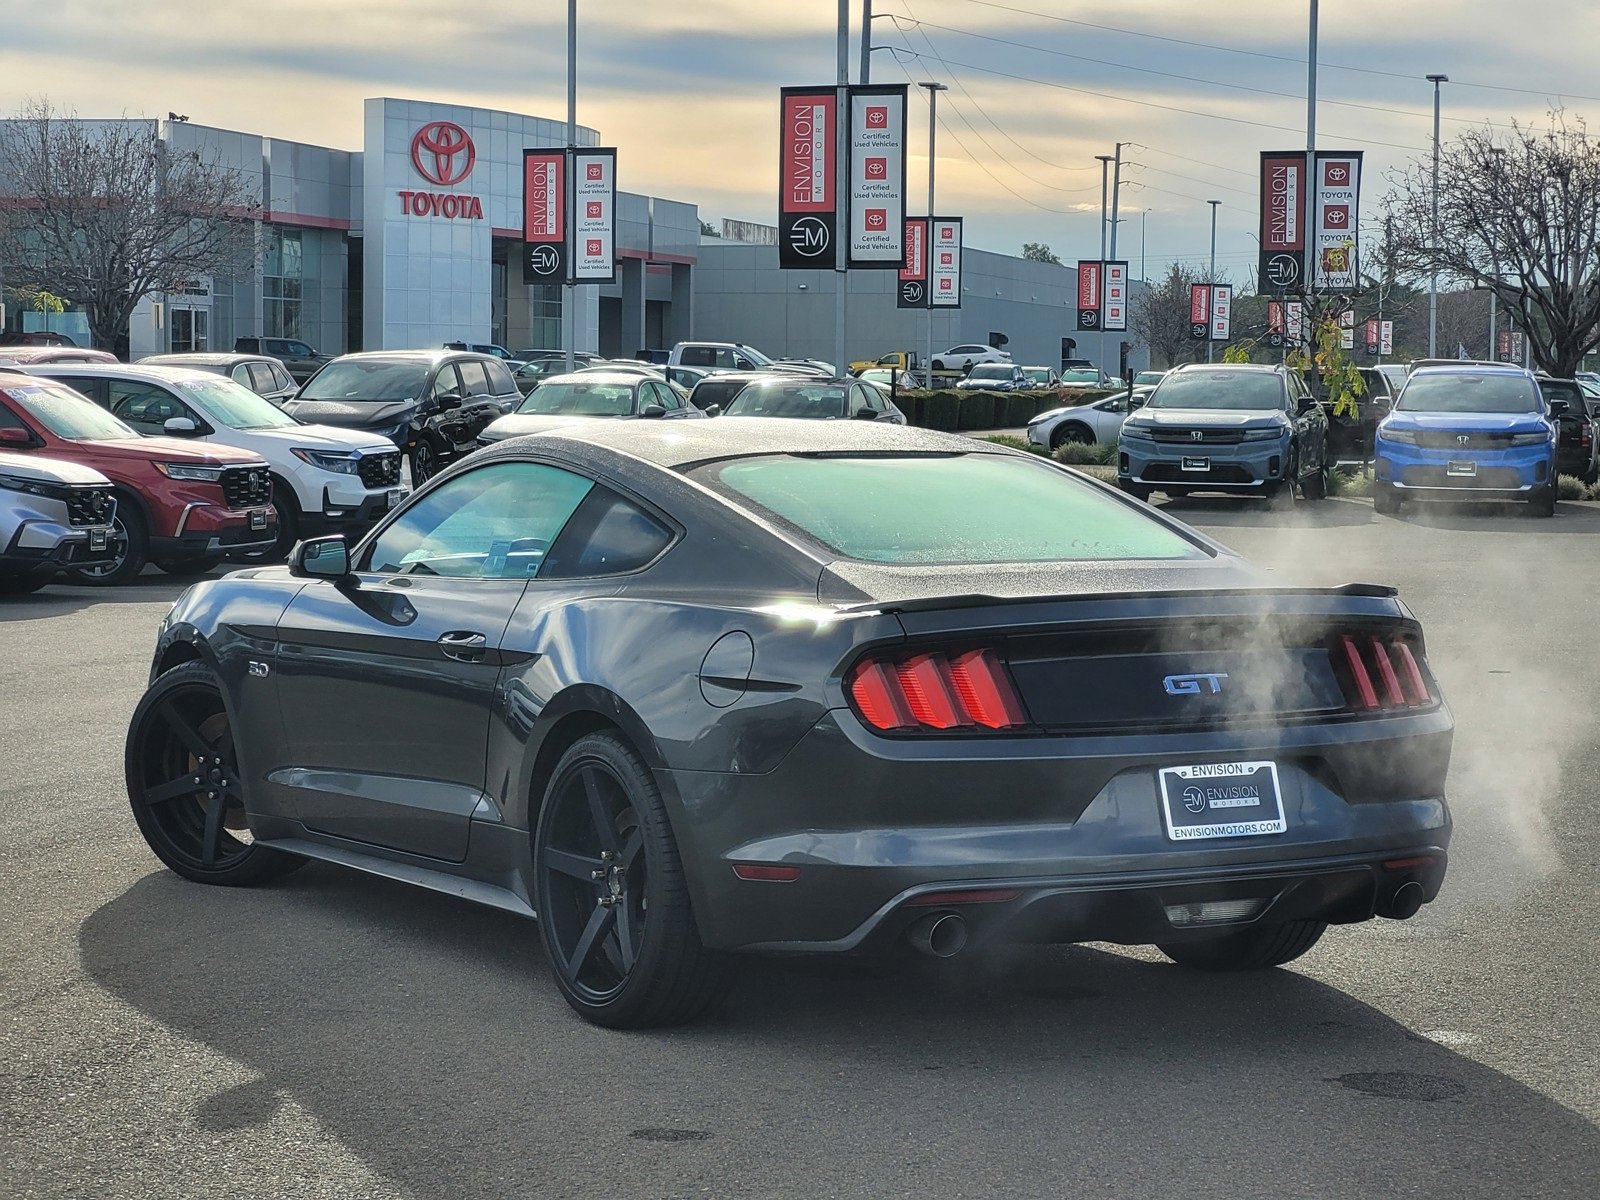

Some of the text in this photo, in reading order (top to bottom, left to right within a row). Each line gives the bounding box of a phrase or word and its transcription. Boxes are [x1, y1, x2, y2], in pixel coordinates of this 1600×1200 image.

[794, 106, 812, 202] ENVISION
[814, 114, 822, 194] MOTORS
[398, 192, 484, 219] TOYOTA
[533, 162, 546, 235] ENVISION
[1272, 166, 1286, 243] ENVISION
[1162, 672, 1229, 694] GT
[1192, 764, 1243, 777] ENVISION
[1207, 786, 1259, 800] ENVISION
[1174, 822, 1281, 838] ENVISIONMOTORS.COM
